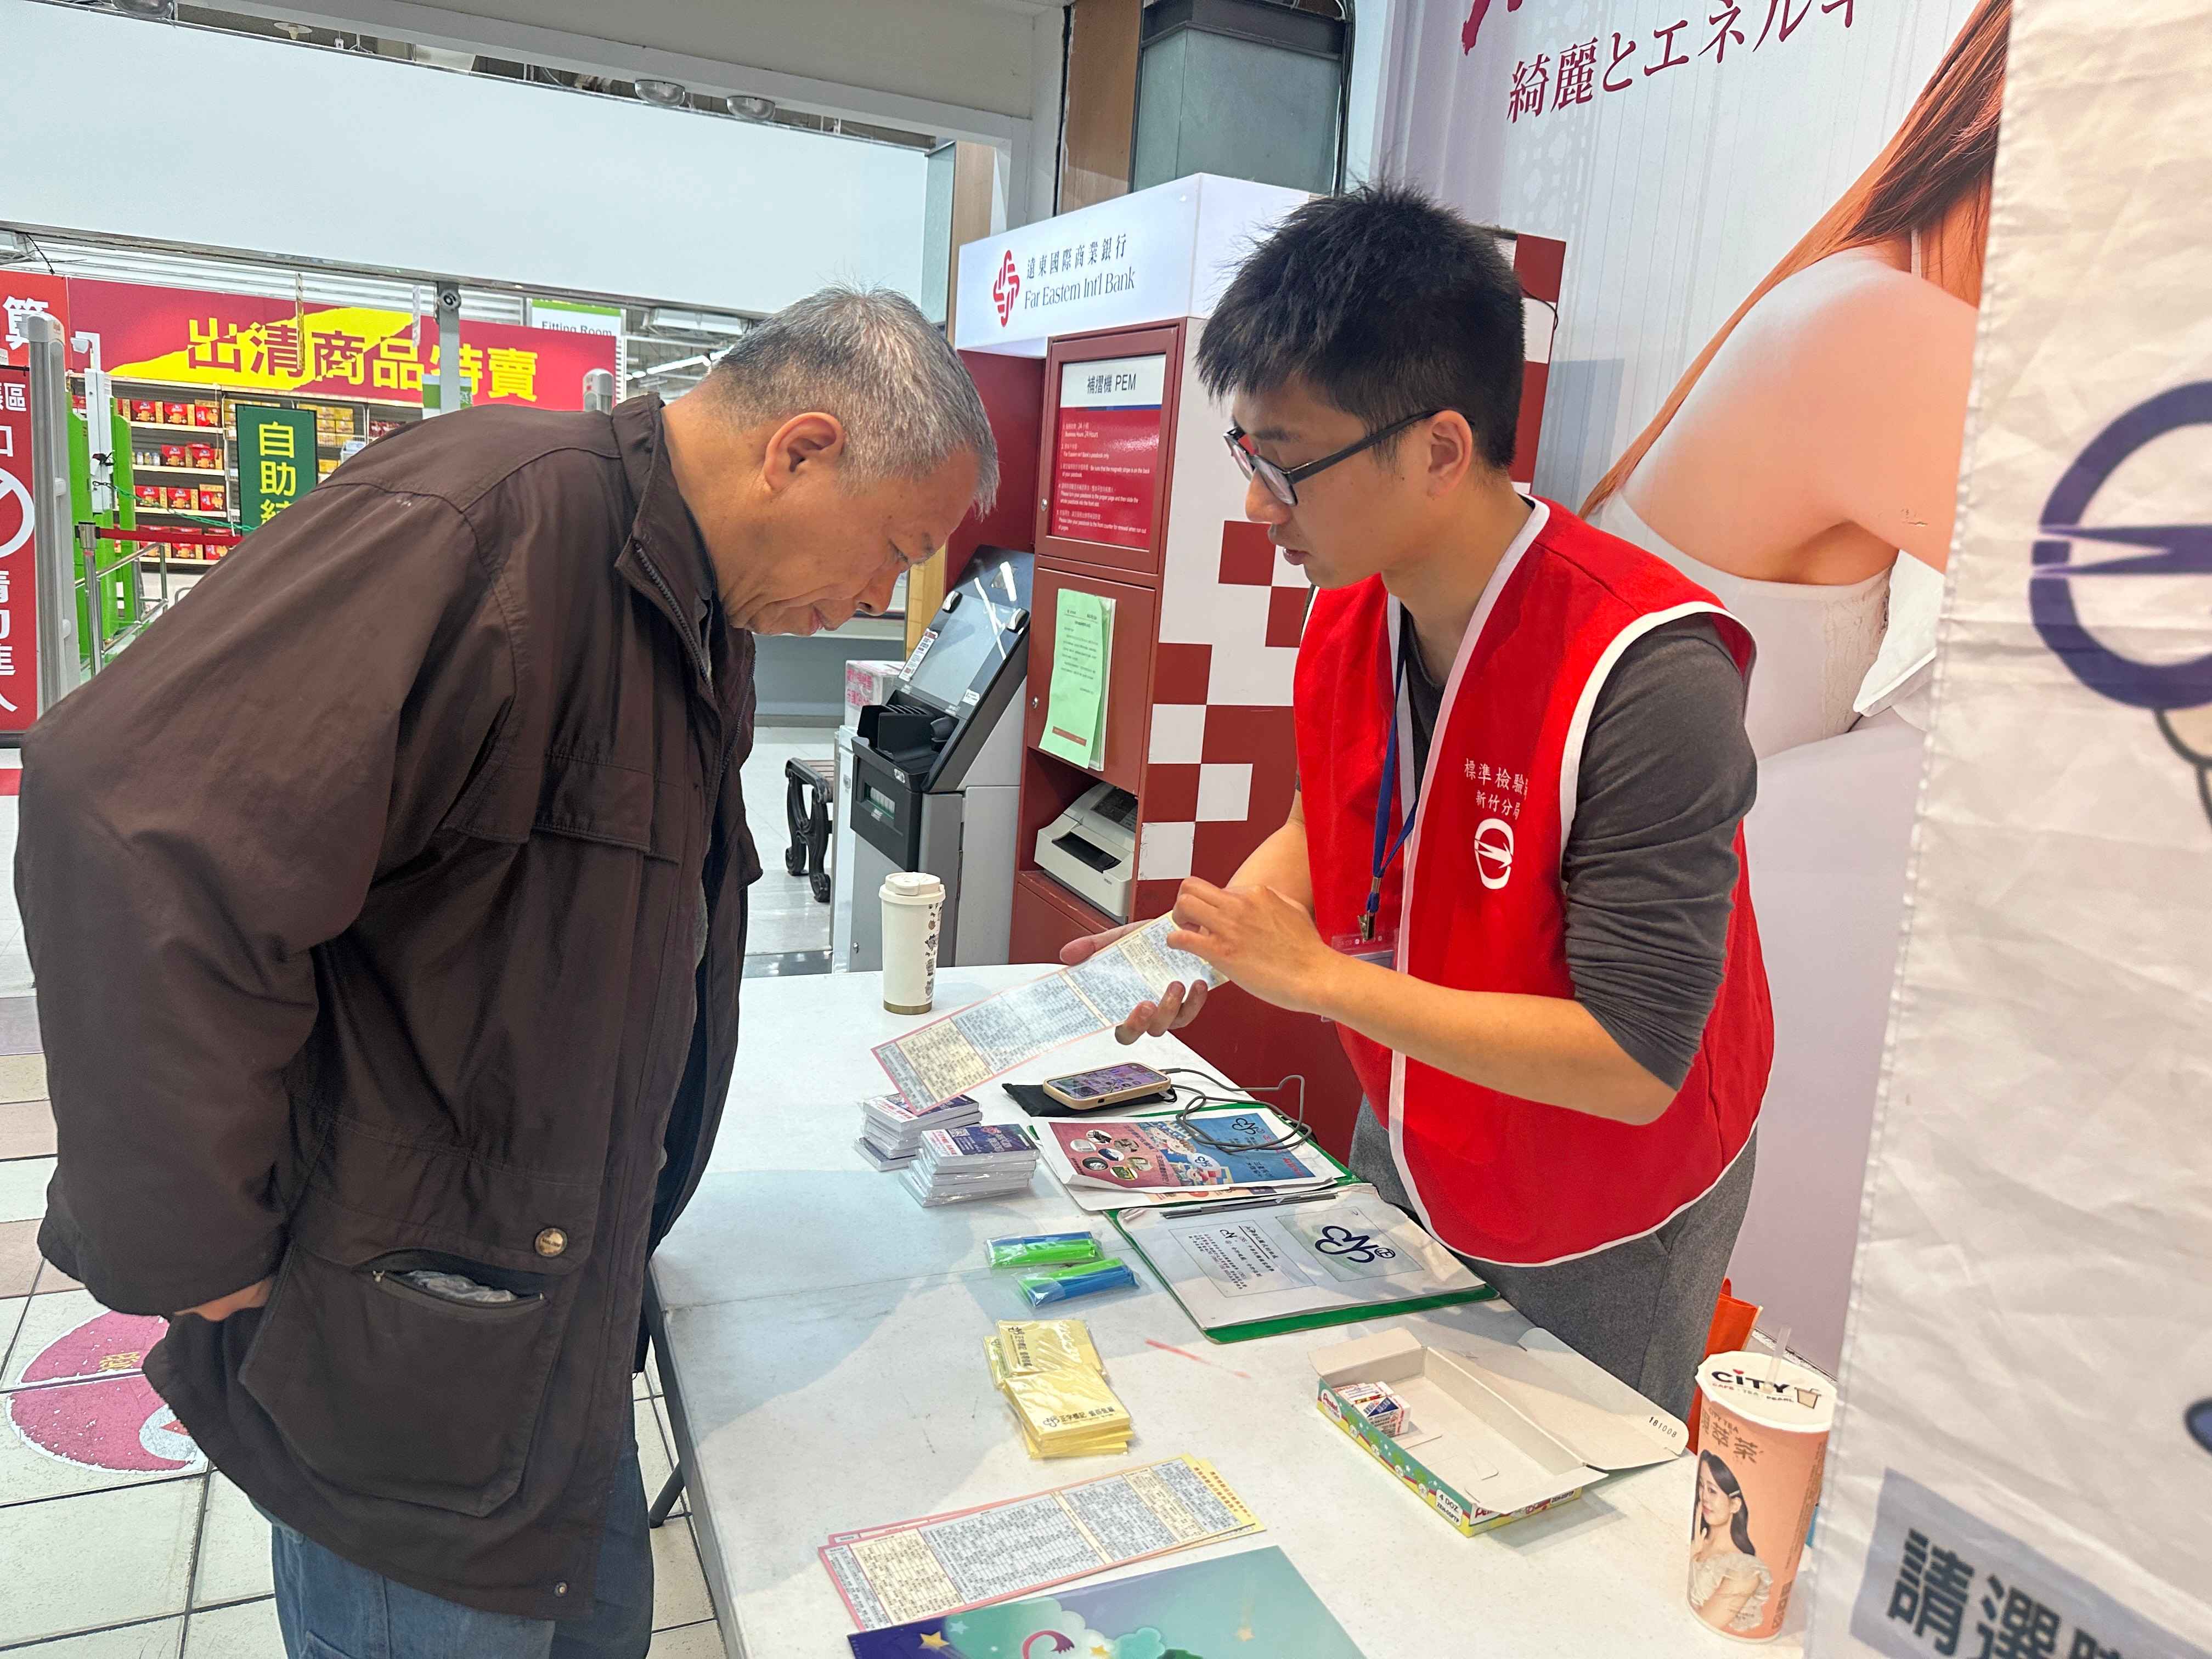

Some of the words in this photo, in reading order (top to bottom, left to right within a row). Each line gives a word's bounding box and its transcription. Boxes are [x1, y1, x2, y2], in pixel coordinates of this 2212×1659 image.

[1026, 233, 1126, 279] 遠東國際商業銀行
[1025, 289, 1040, 309] Far
[1042, 283, 1080, 306] Eastern
[1105, 266, 1135, 294] Bank
[188, 317, 538, 403] 出清商品特賣
[1115, 373, 1137, 391] PEM
[1649, 1417, 1677, 1438] 181008
[1887, 1527, 2126, 1659] 請選
